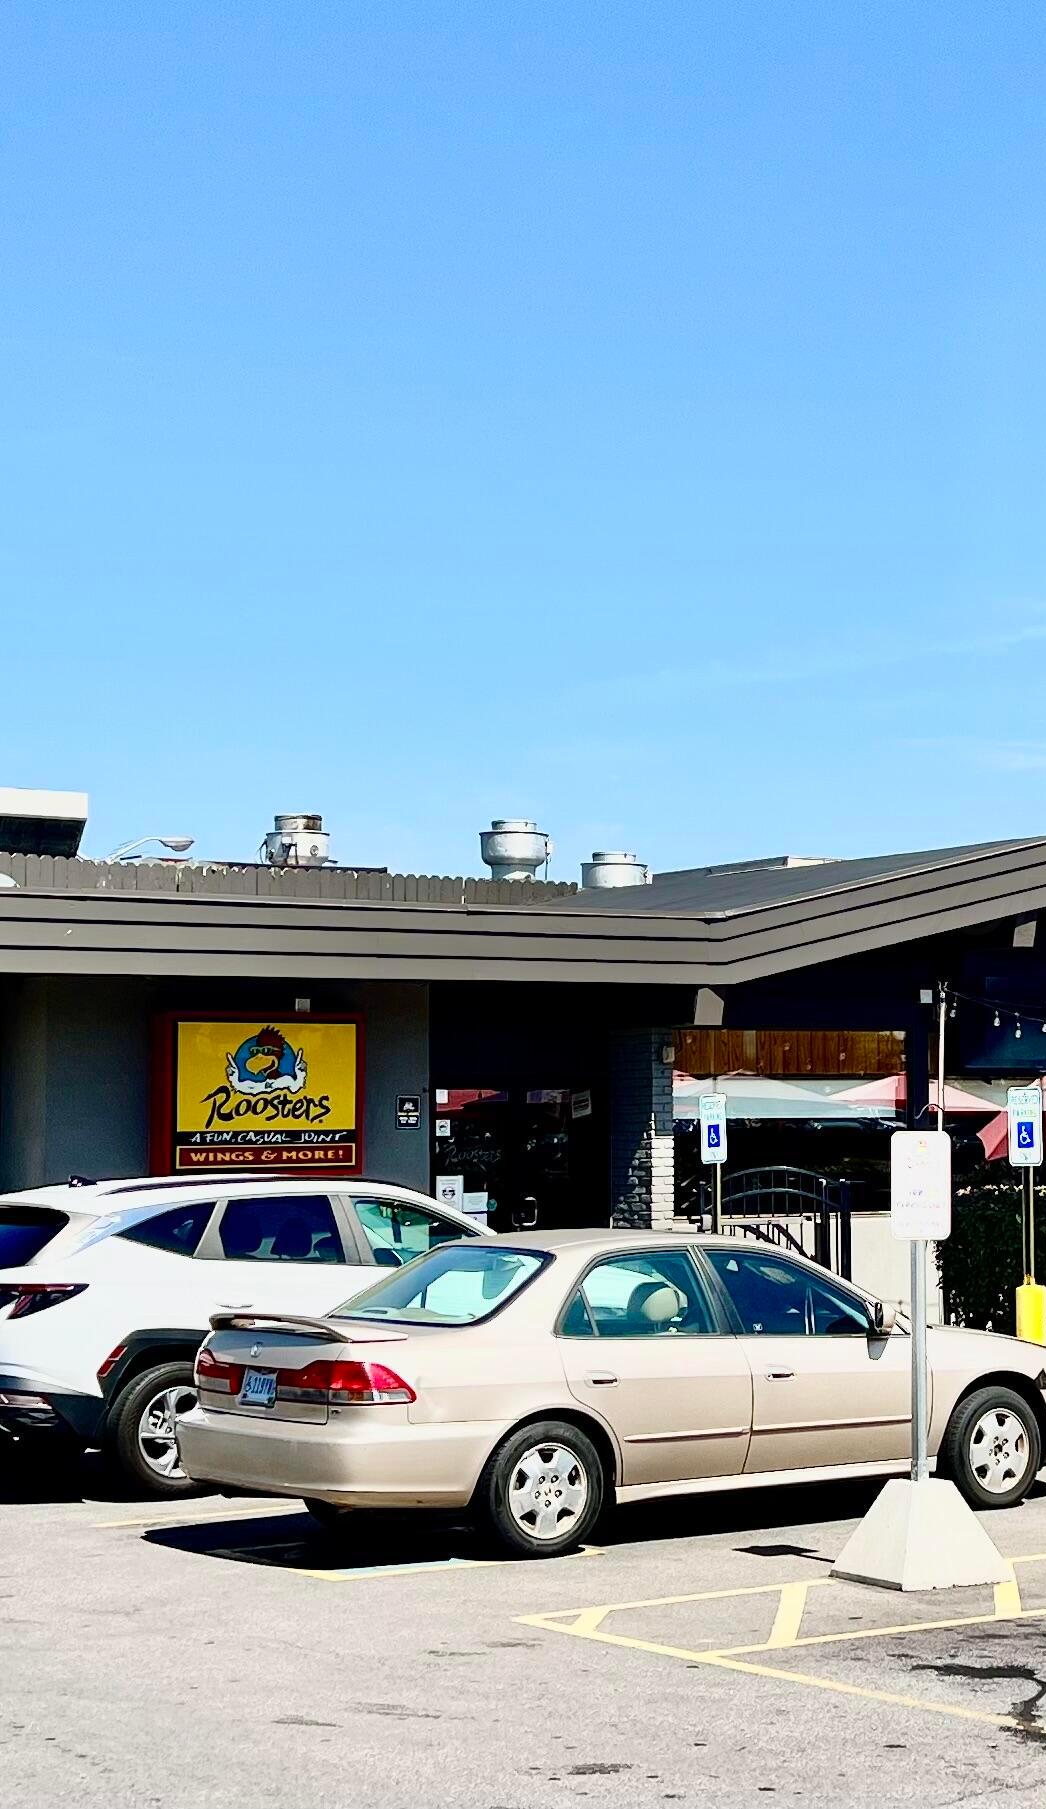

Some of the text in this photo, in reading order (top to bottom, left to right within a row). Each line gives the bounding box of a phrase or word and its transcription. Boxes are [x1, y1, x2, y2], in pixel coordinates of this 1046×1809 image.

[200, 1085, 332, 1130] Roosters
[189, 1131, 201, 1143] A
[237, 1131, 292, 1144] CASUAL
[293, 1131, 347, 1143] JOINT
[190, 1149, 344, 1161] WINGS & MORE!
